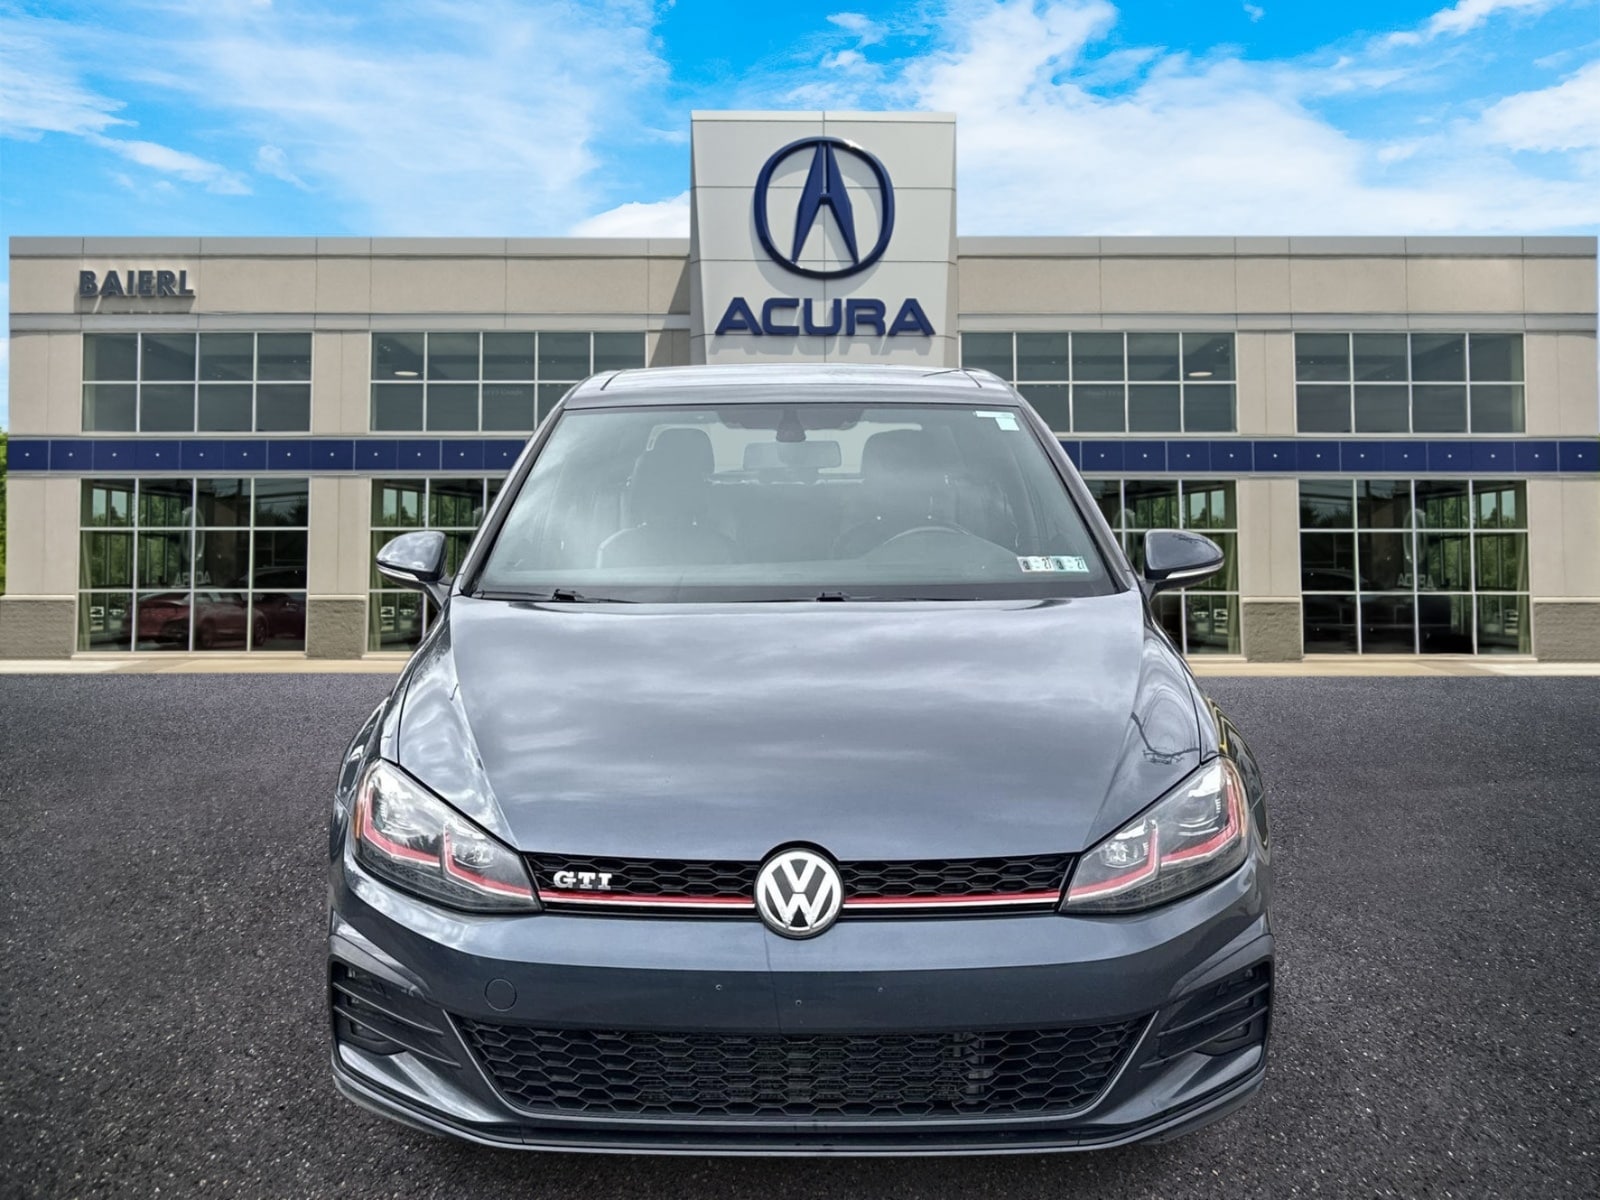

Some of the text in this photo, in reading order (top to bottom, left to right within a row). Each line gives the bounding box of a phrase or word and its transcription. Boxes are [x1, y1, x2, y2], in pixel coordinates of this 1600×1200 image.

[79, 269, 195, 297] BAIERL
[714, 296, 936, 337] ACURA
[553, 870, 613, 891] GTI
